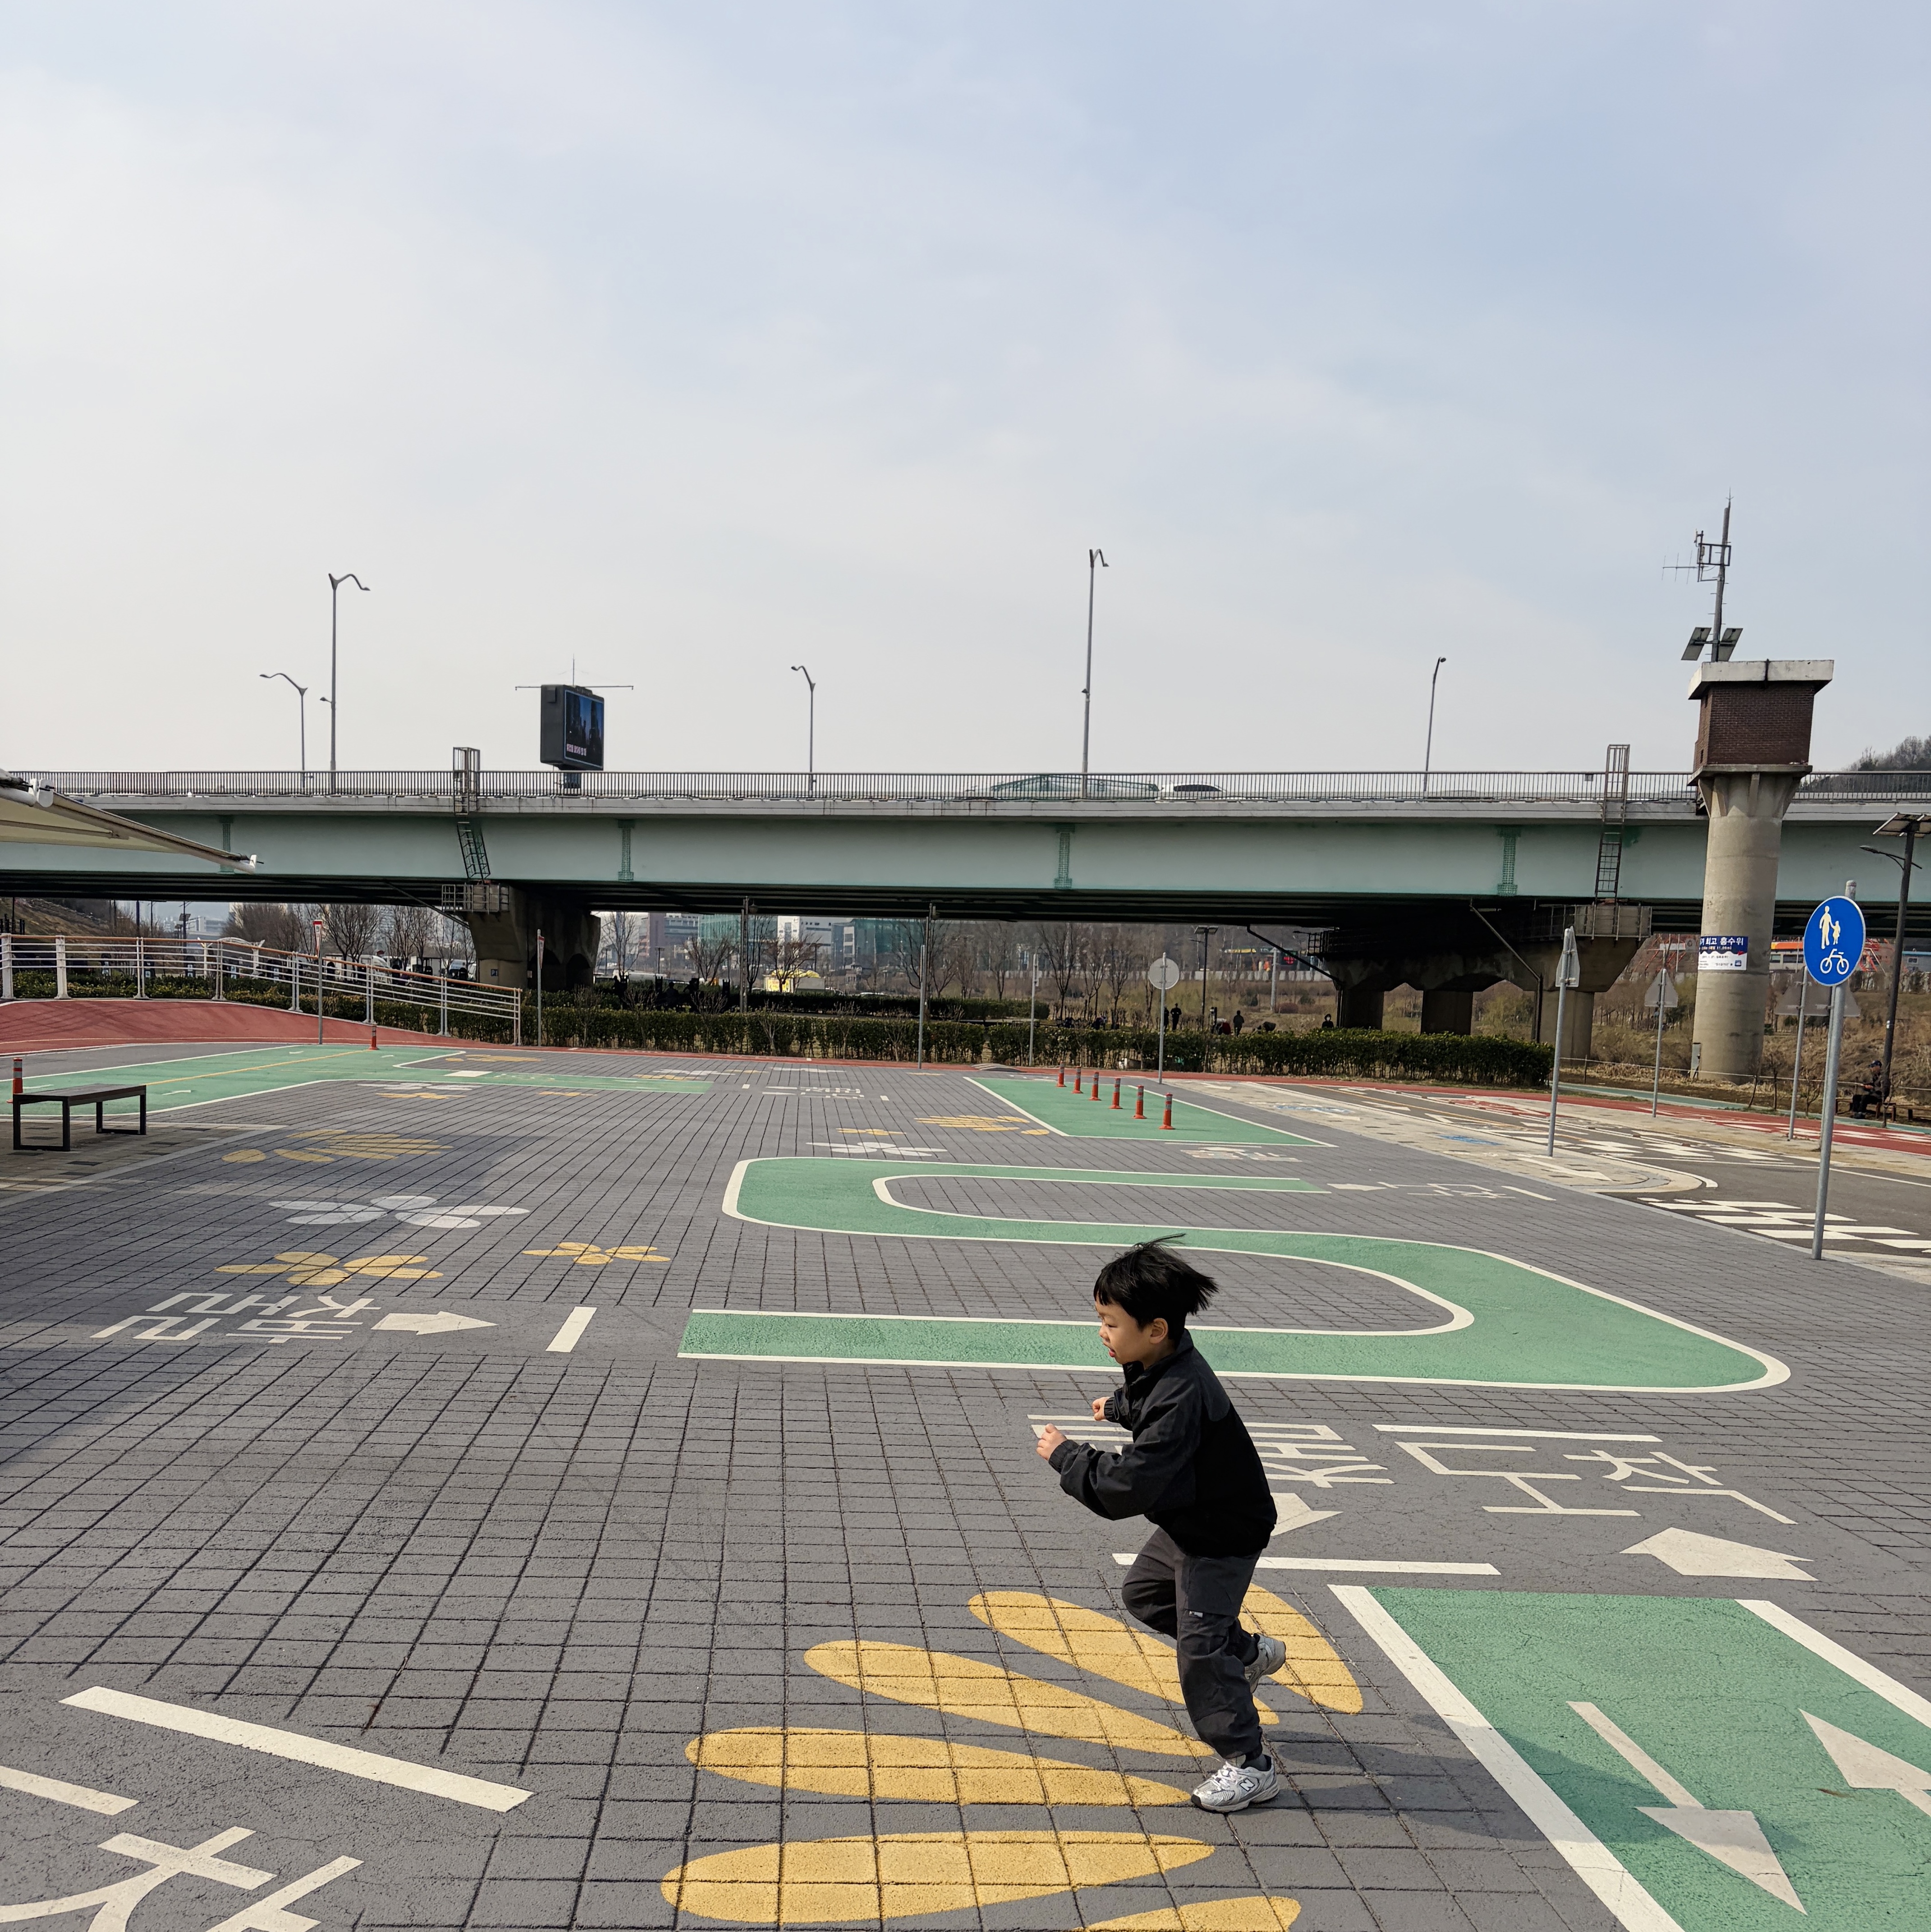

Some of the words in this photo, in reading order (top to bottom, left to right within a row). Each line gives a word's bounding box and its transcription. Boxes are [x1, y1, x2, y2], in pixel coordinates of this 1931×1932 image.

[89, 1292, 381, 1344] 출발
[1394, 1441, 1798, 1525] 도착
[1239, 1778, 1255, 1791] N
